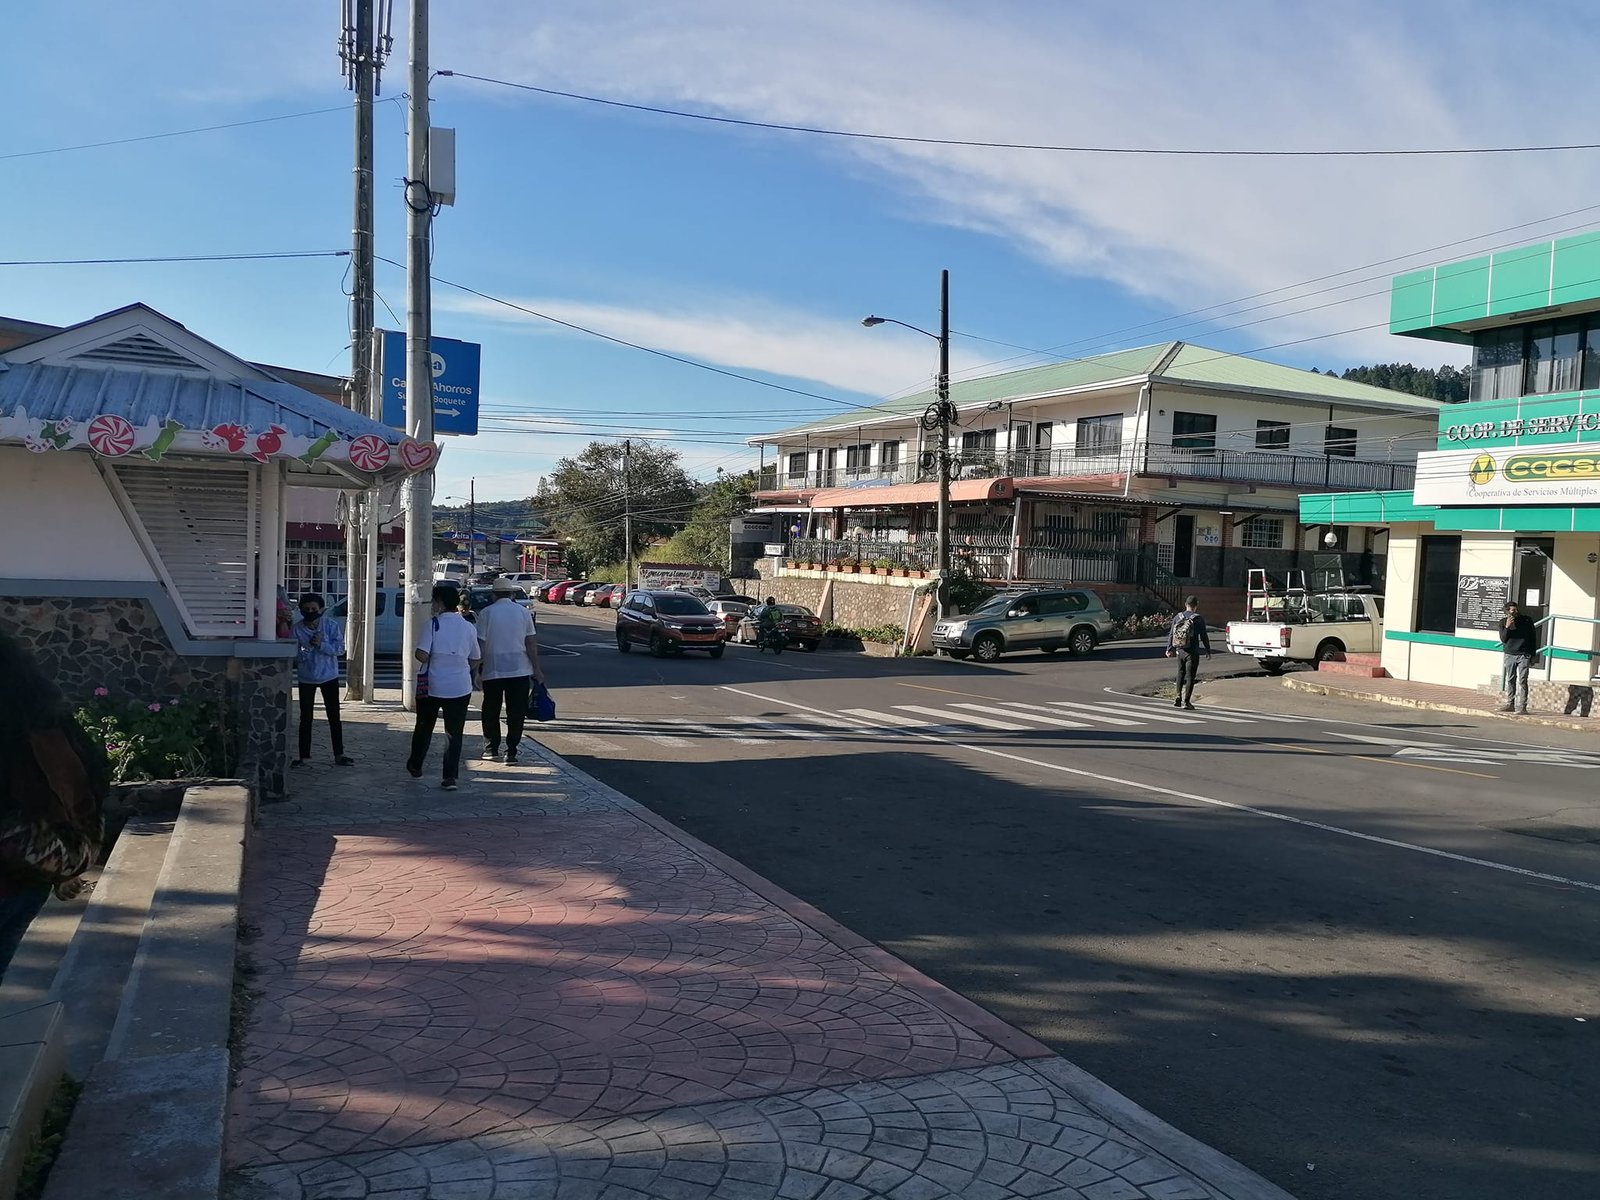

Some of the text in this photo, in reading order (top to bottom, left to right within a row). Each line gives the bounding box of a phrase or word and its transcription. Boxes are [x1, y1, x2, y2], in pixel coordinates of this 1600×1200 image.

[433, 382, 472, 395] Ahorros
[1446, 423, 1498, 441] COOP.
[1500, 419, 1525, 437] DE
[1468, 486, 1598, 498] Cooperativa de Servicios Múltiples
